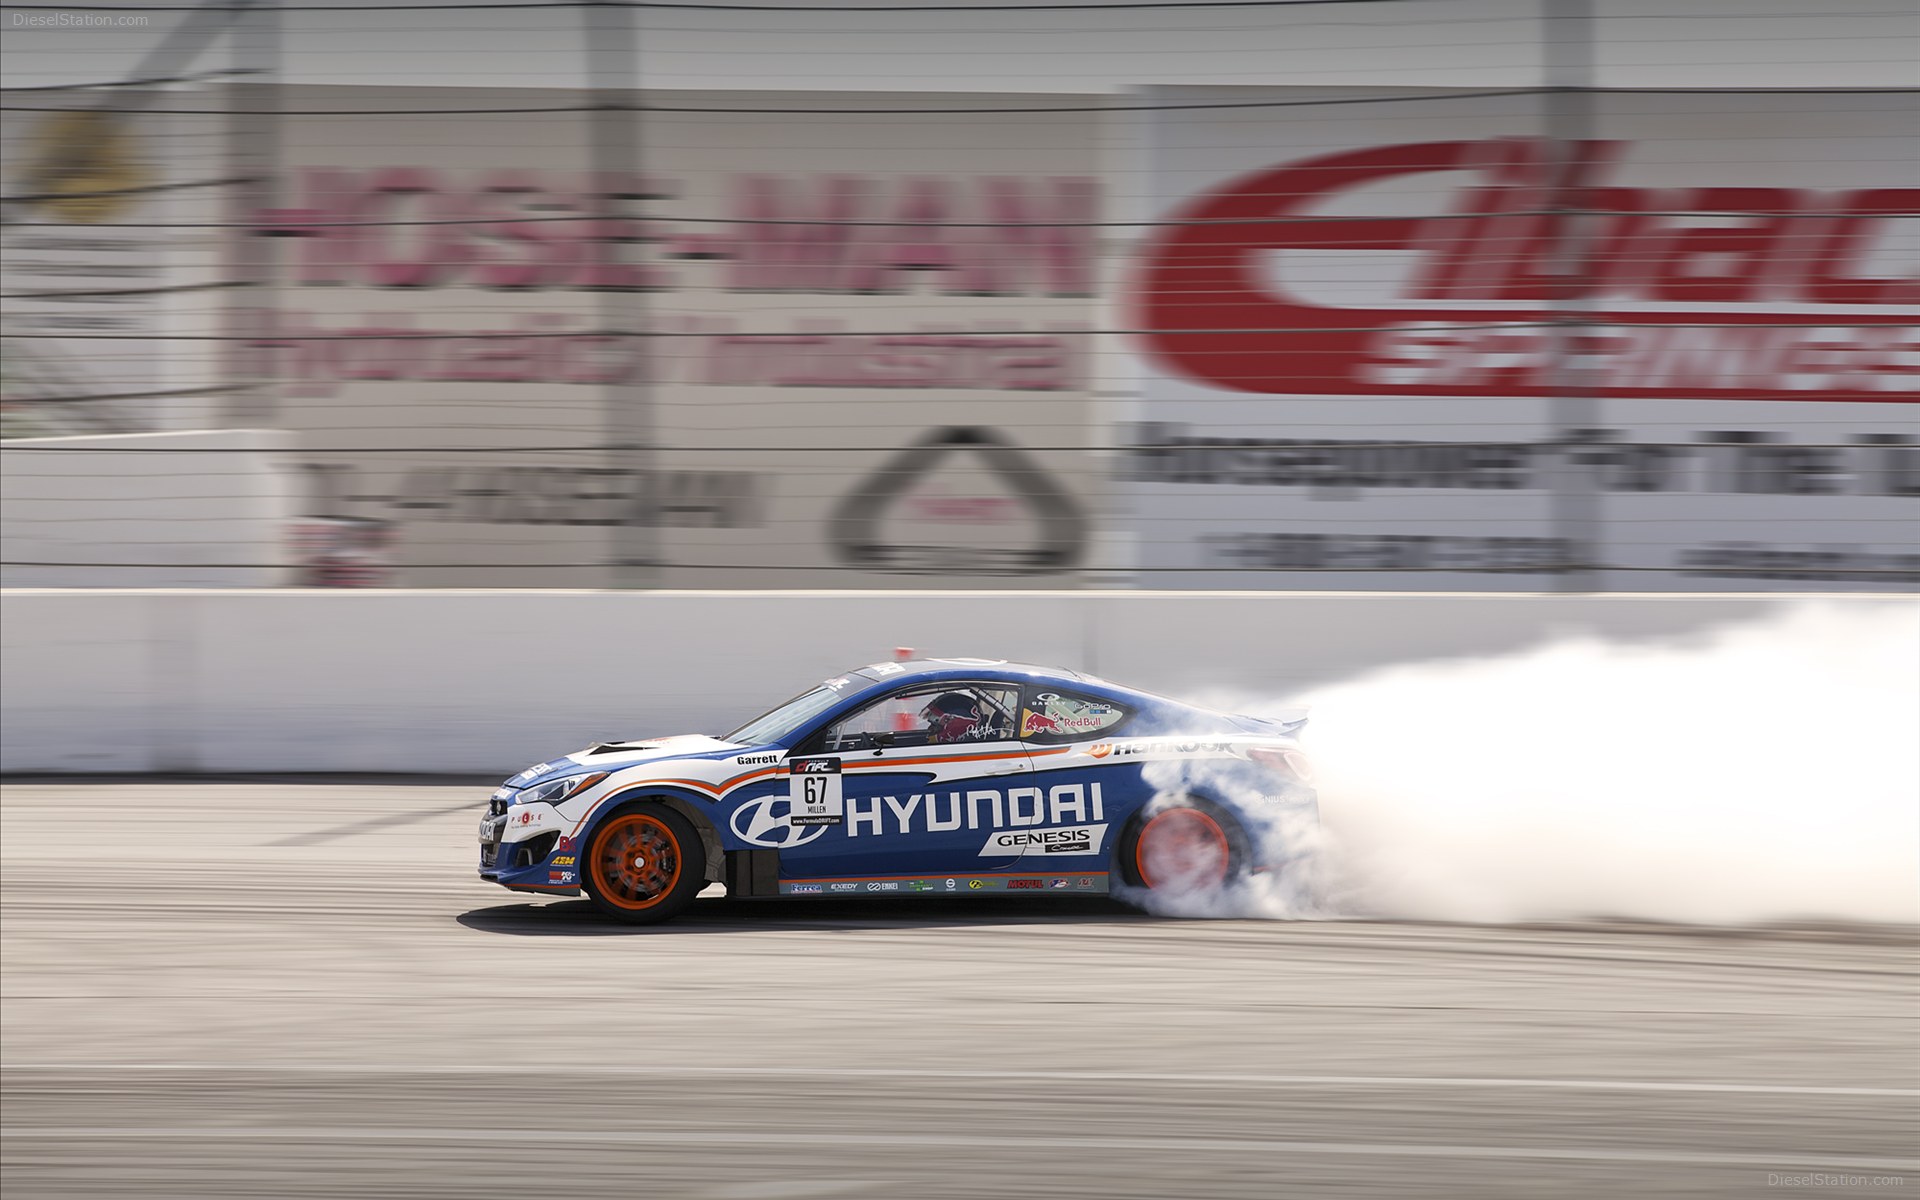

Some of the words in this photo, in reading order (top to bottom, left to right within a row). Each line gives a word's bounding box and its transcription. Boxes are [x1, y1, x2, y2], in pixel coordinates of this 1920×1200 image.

[1064, 718, 1082, 727] Red
[1084, 717, 1101, 726] Bull
[737, 755, 778, 765] Garrett
[804, 777, 827, 804] 67
[808, 805, 826, 814] MILLEN
[846, 783, 1104, 837] HYUNDAI
[997, 829, 1090, 847] GENESIS
[552, 856, 576, 865] AEM
[1007, 879, 1044, 889] MOTUL
